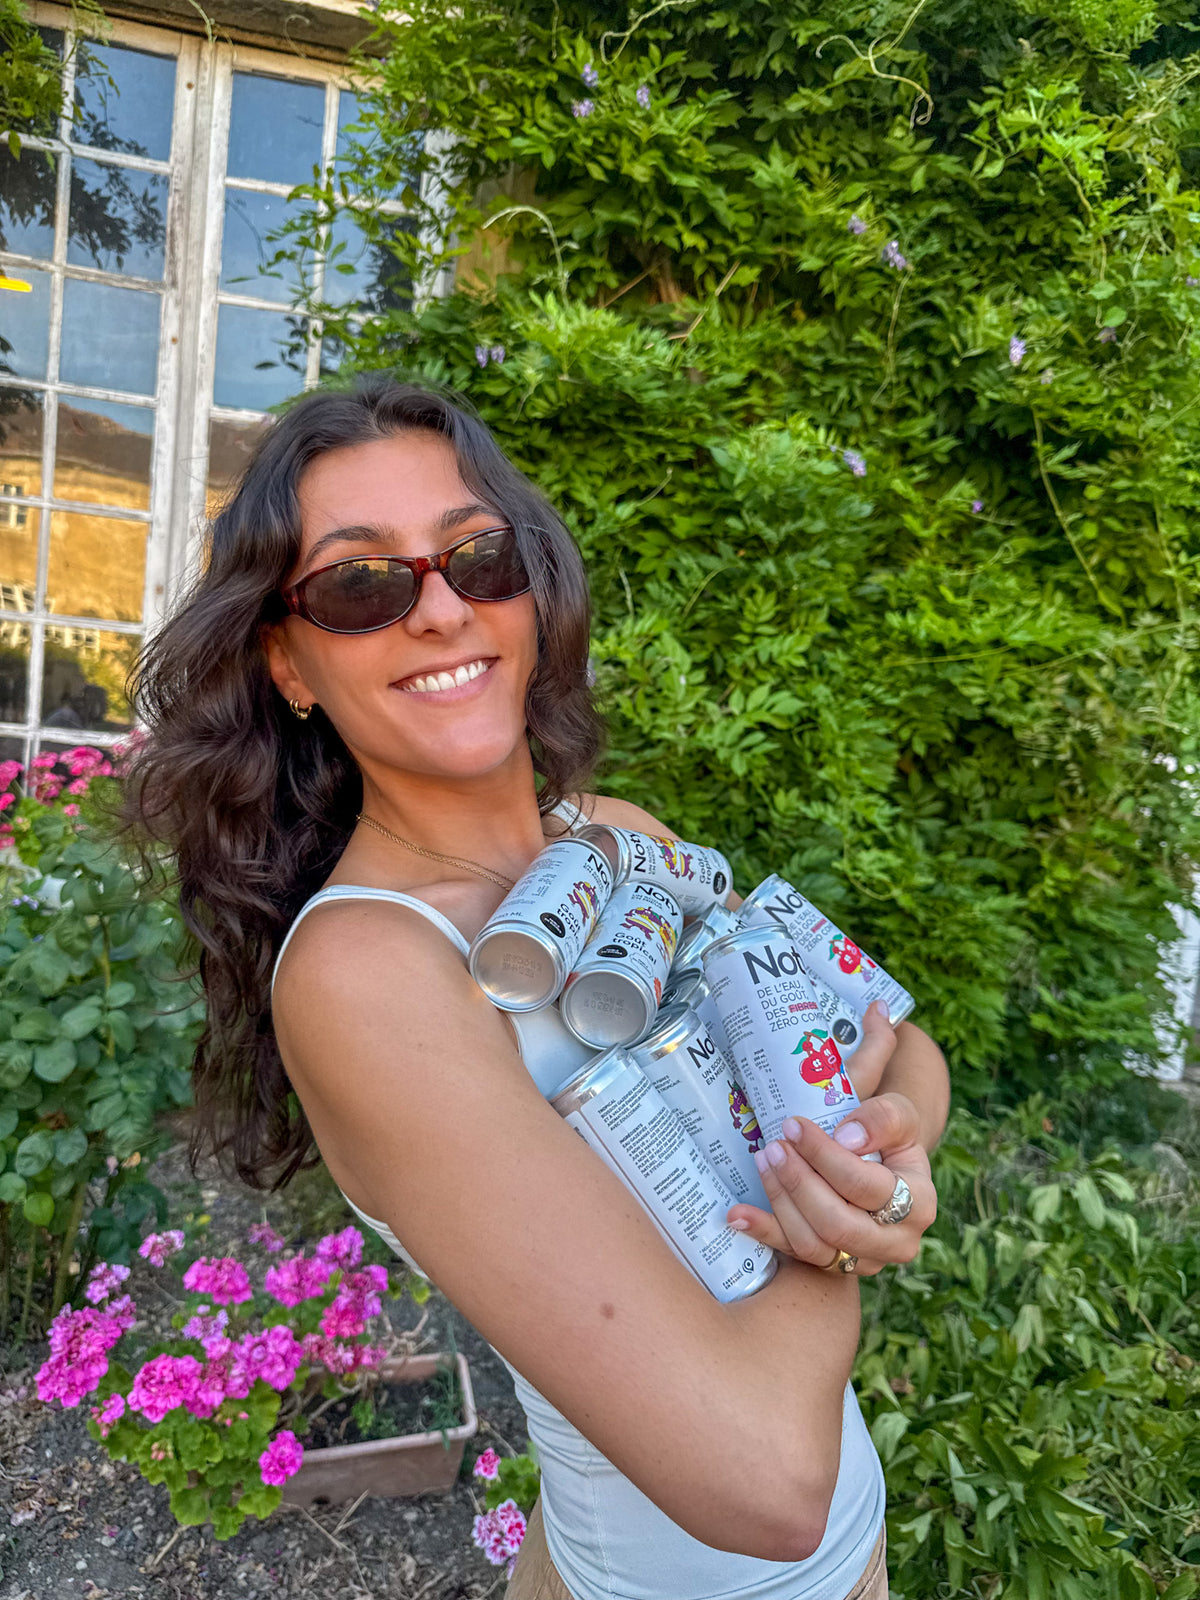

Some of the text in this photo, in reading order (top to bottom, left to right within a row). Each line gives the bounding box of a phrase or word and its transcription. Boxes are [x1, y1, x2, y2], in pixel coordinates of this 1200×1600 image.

[619, 833, 646, 873] Noty
[698, 858, 706, 883] Goût
[634, 885, 678, 916] Noty
[560, 904, 580, 930] Goût
[615, 932, 646, 946] Goût
[791, 926, 803, 940] DU
[797, 929, 813, 947] DES
[803, 931, 823, 952] ZÉRO
[613, 938, 657, 965] tropical
[743, 945, 806, 985] Not
[756, 979, 803, 998] DE L'EAU,
[760, 989, 809, 1010] DU GOÛT,
[765, 1006, 788, 1020] DES
[769, 1014, 799, 1031] ZÉRO
[701, 1067, 711, 1079] UN
[705, 1074, 715, 1085] EN
[597, 1098, 615, 1114] TROPICAL
[600, 1103, 617, 1118] BOISSON
[609, 1121, 620, 1131] AVEC
[653, 1167, 679, 1191] INFORMATIONS
[656, 1167, 687, 1195] NUTRITIONNELLES
[676, 1207, 695, 1224] GLUCIDES
